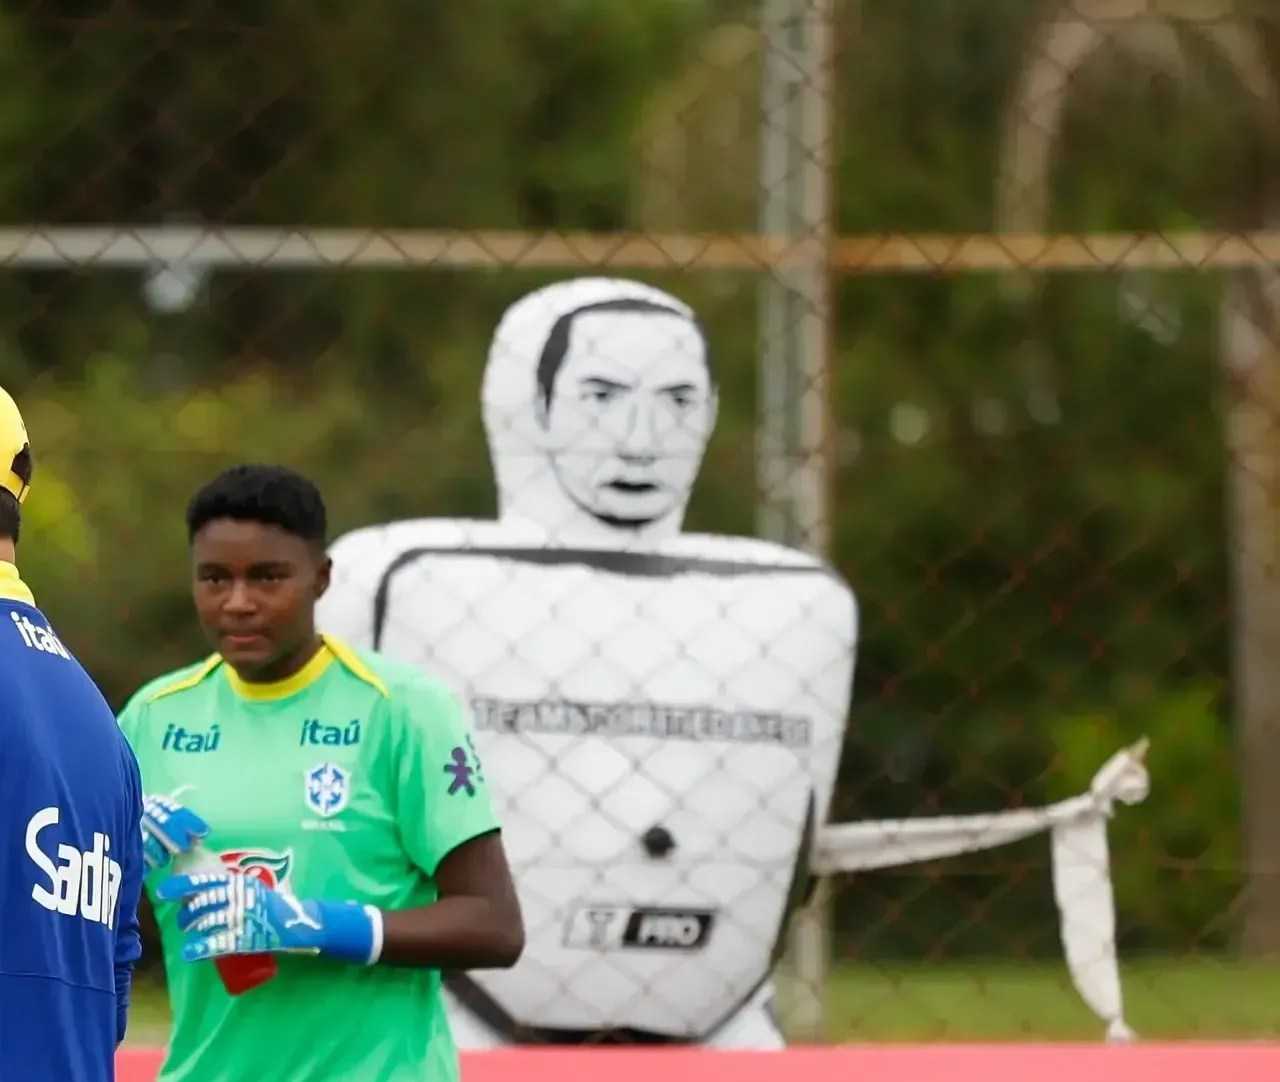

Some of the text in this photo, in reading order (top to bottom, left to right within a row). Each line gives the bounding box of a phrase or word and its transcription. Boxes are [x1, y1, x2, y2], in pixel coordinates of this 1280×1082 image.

[162, 723, 221, 753] itaú
[300, 719, 360, 747] itaú
[25, 807, 122, 931] Sadia
